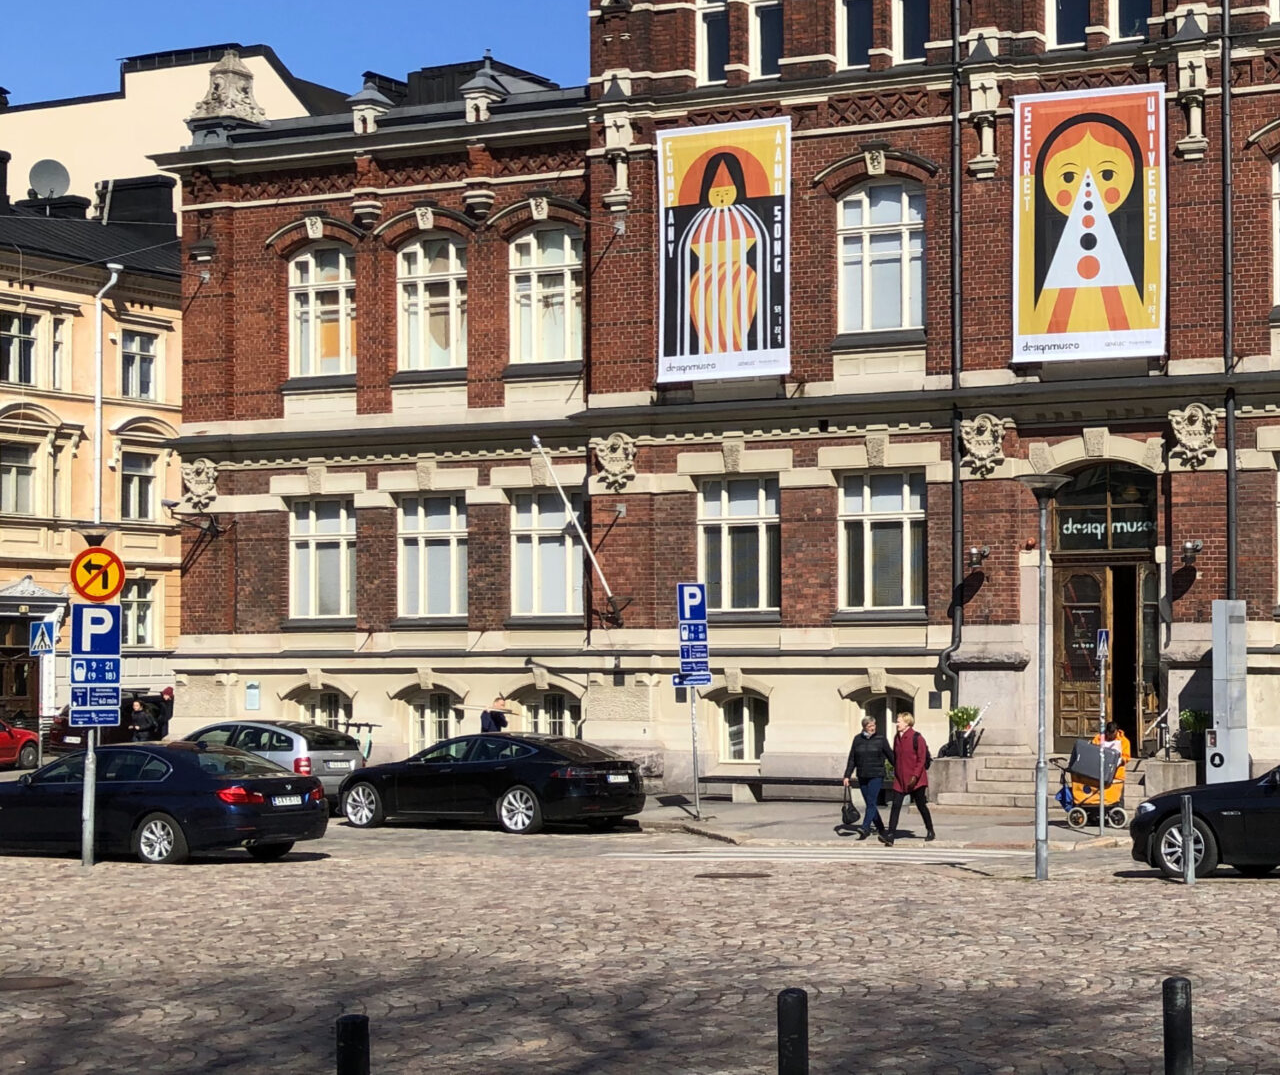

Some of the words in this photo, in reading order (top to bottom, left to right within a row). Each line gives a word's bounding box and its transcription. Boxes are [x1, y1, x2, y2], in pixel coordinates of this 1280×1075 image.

[774, 129, 782, 195] AAMU
[1023, 106, 1032, 212] SECRET
[1146, 96, 1157, 241] UNIVERSE
[666, 141, 675, 258] COMPANY
[773, 205, 782, 273] SONG
[665, 361, 717, 374] designmuseo
[1022, 341, 1080, 355] designmuseo
[683, 586, 702, 619] P
[82, 607, 113, 651] P
[87, 671, 97, 680] (9
[105, 671, 117, 680] 18)
[91, 661, 97, 670] 9
[105, 661, 114, 670] 21
